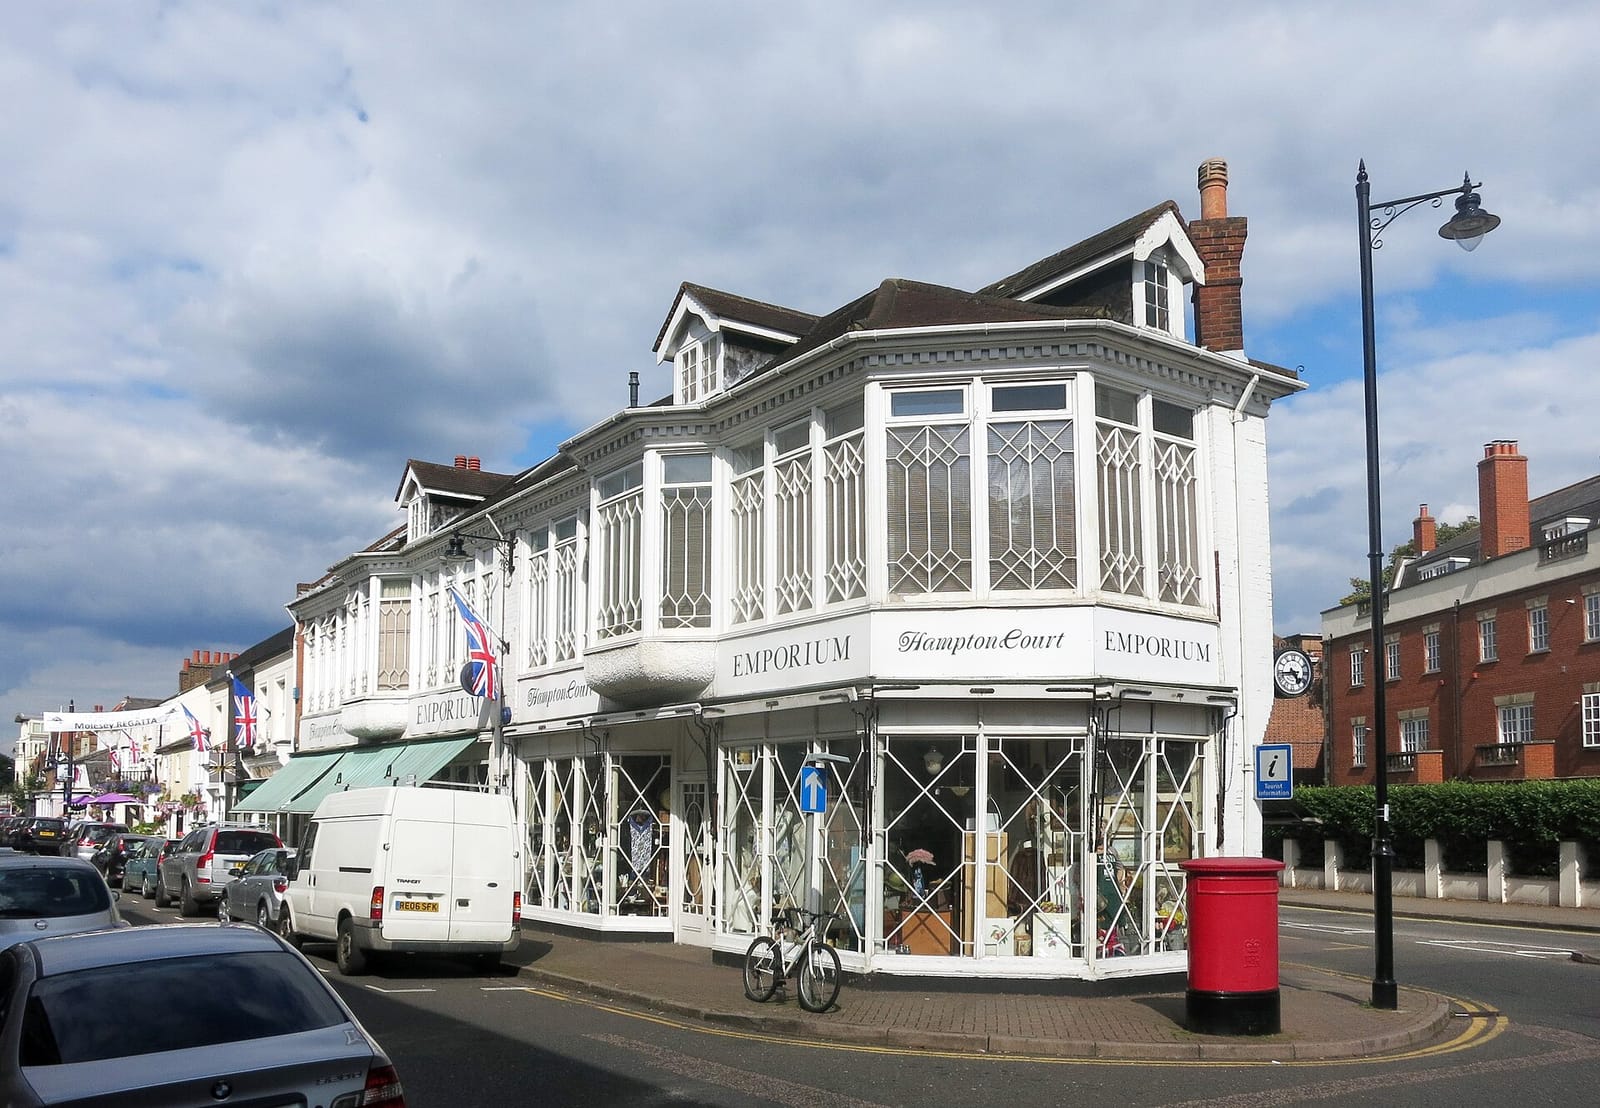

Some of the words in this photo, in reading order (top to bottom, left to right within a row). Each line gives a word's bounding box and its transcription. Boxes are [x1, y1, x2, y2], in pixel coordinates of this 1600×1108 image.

[732, 634, 851, 677] EMPORIUM
[898, 630, 997, 656] Hampton
[998, 628, 1065, 650] Court
[1104, 630, 1210, 663] EMPORIUM
[416, 696, 479, 725] EMPORIUM
[527, 686, 567, 708] Hampton
[116, 717, 158, 728] REGATTA
[399, 901, 421, 911] RE06
[422, 902, 438, 912] SFK
